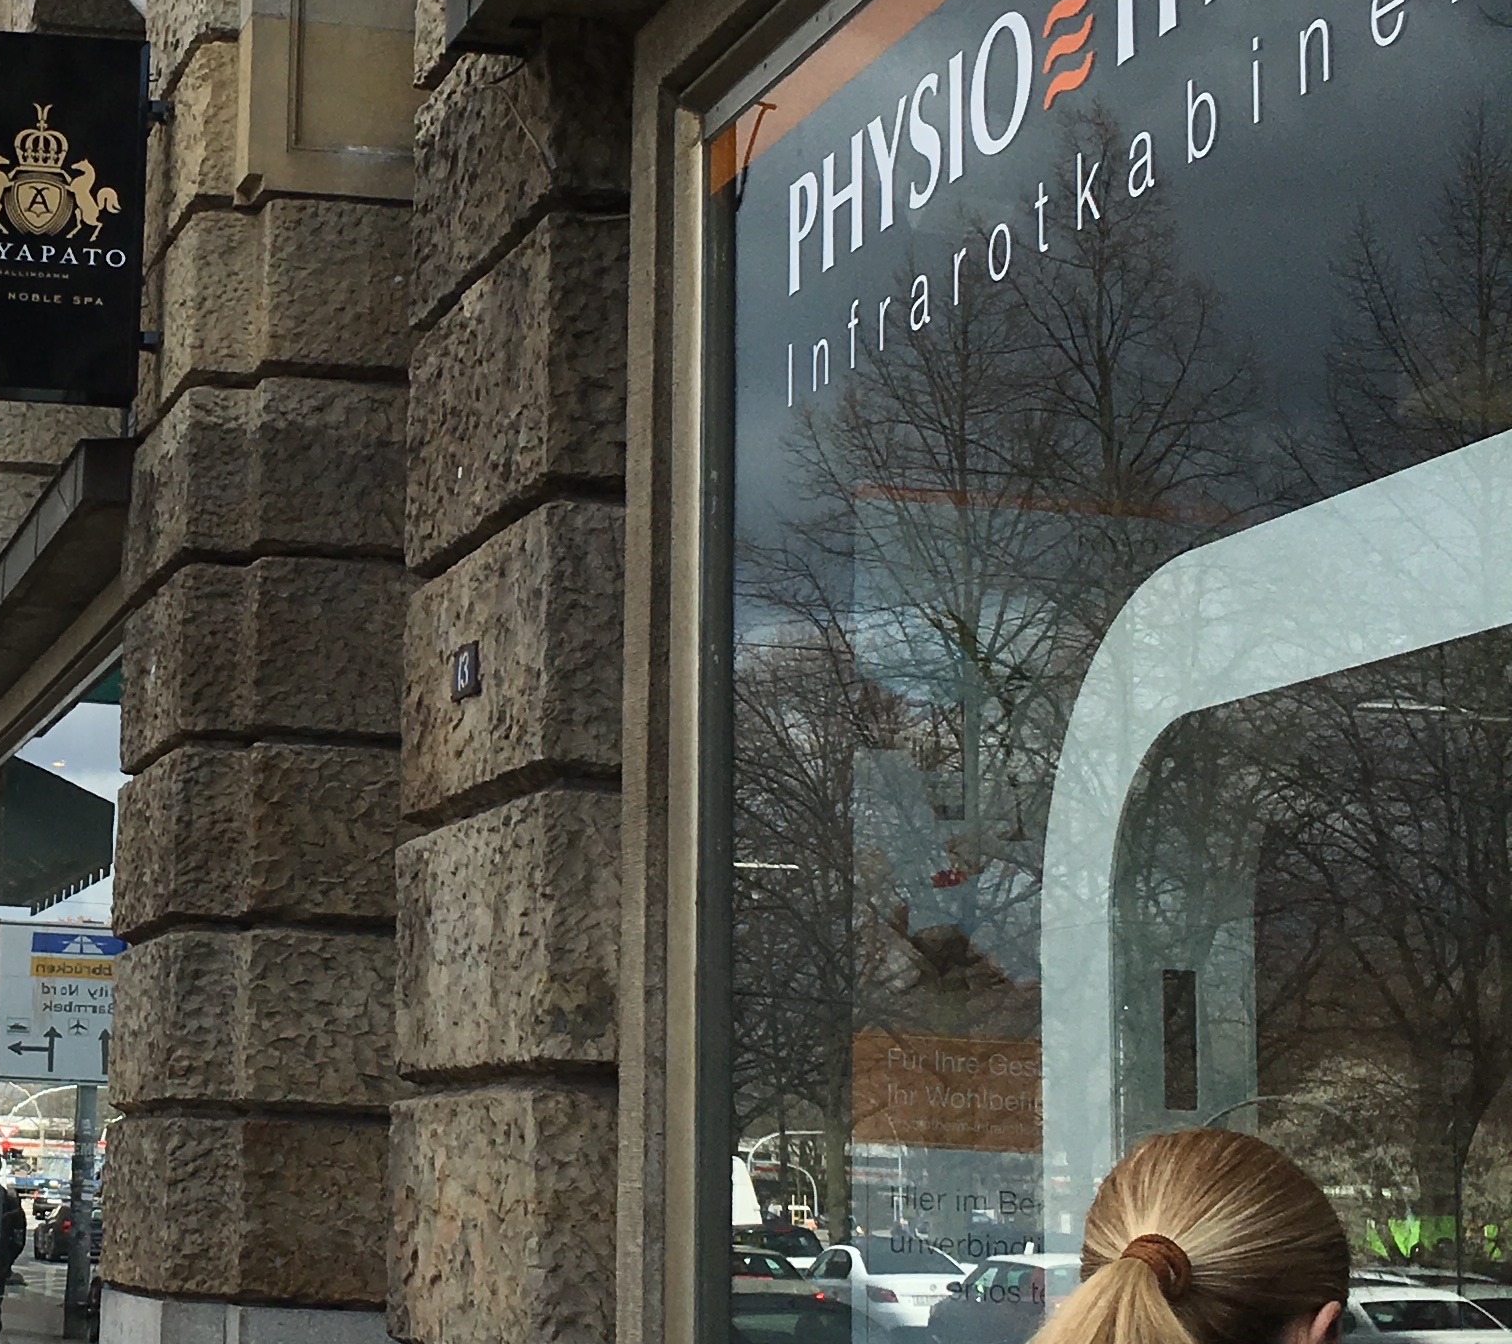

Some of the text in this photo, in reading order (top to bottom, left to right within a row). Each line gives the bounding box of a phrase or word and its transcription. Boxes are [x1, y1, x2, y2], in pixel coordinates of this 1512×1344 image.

[787, 10, 1034, 297] PHYSIO
[8, 292, 62, 304] NOBLE
[72, 295, 104, 306] SPA
[935, 1050, 980, 1075] Ihre
[956, 1188, 987, 1212] im
